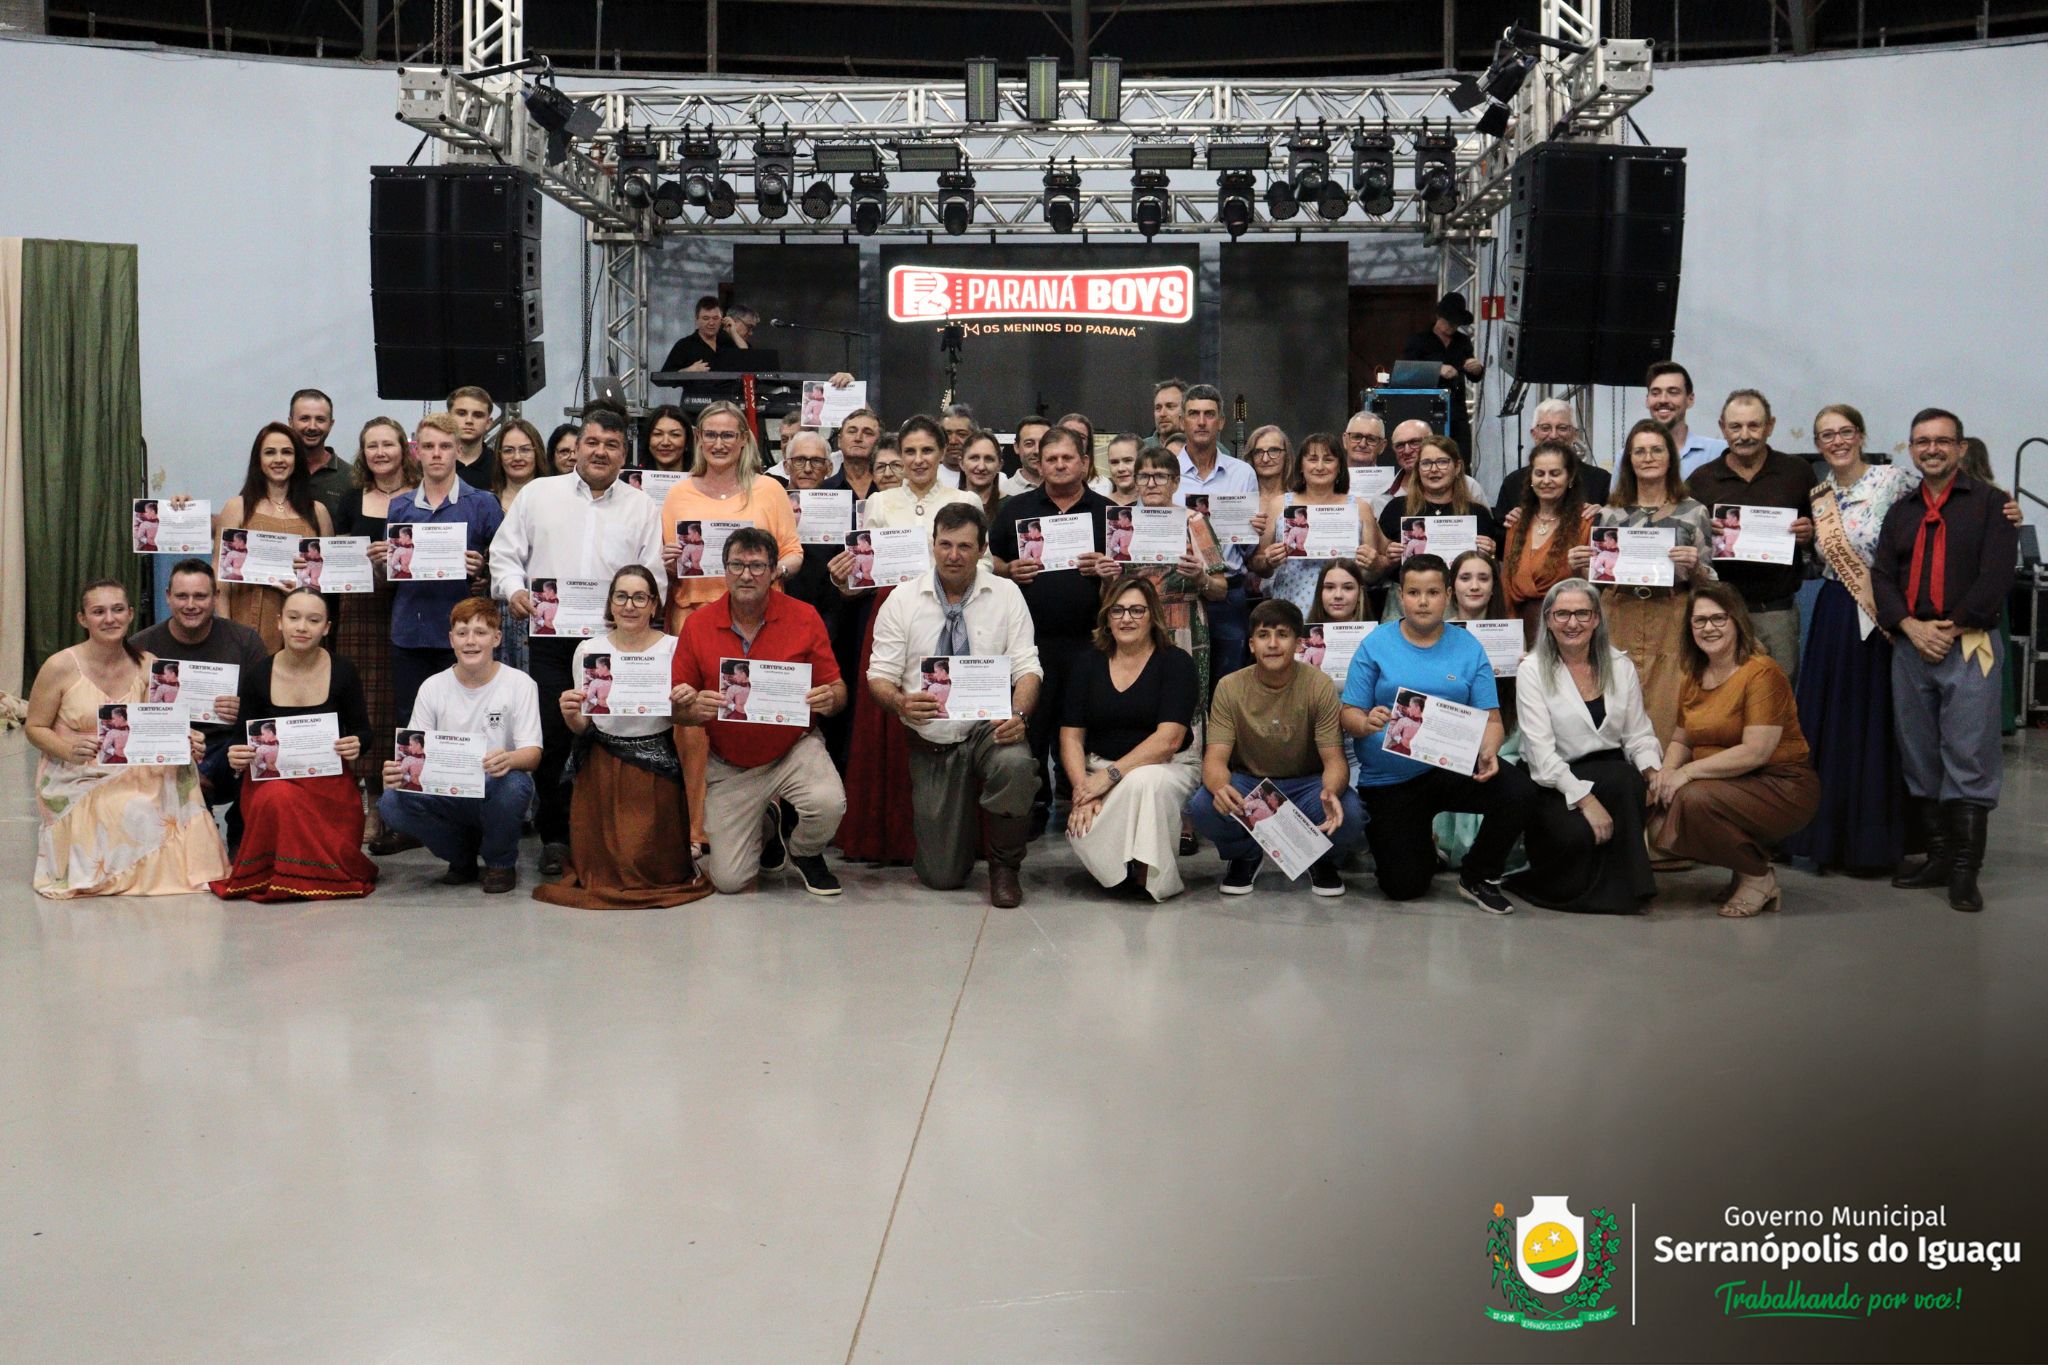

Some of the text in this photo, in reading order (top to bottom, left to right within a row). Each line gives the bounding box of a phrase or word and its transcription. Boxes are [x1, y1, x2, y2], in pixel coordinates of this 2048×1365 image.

[967, 275, 1185, 315] PARANÁ BOYS
[982, 323, 1137, 338] OS MENINOS DO PARANÁ
[256, 533, 288, 541] CERTIFICADO
[189, 664, 224, 672] CERTIFICADO
[759, 664, 796, 672] CERTIFICADO
[1436, 701, 1472, 716] CERTIFICADO
[286, 717, 322, 725] CERTIFICADO
[435, 734, 471, 742] CERTIFICADO
[1292, 808, 1319, 837] CERTIFICADO
